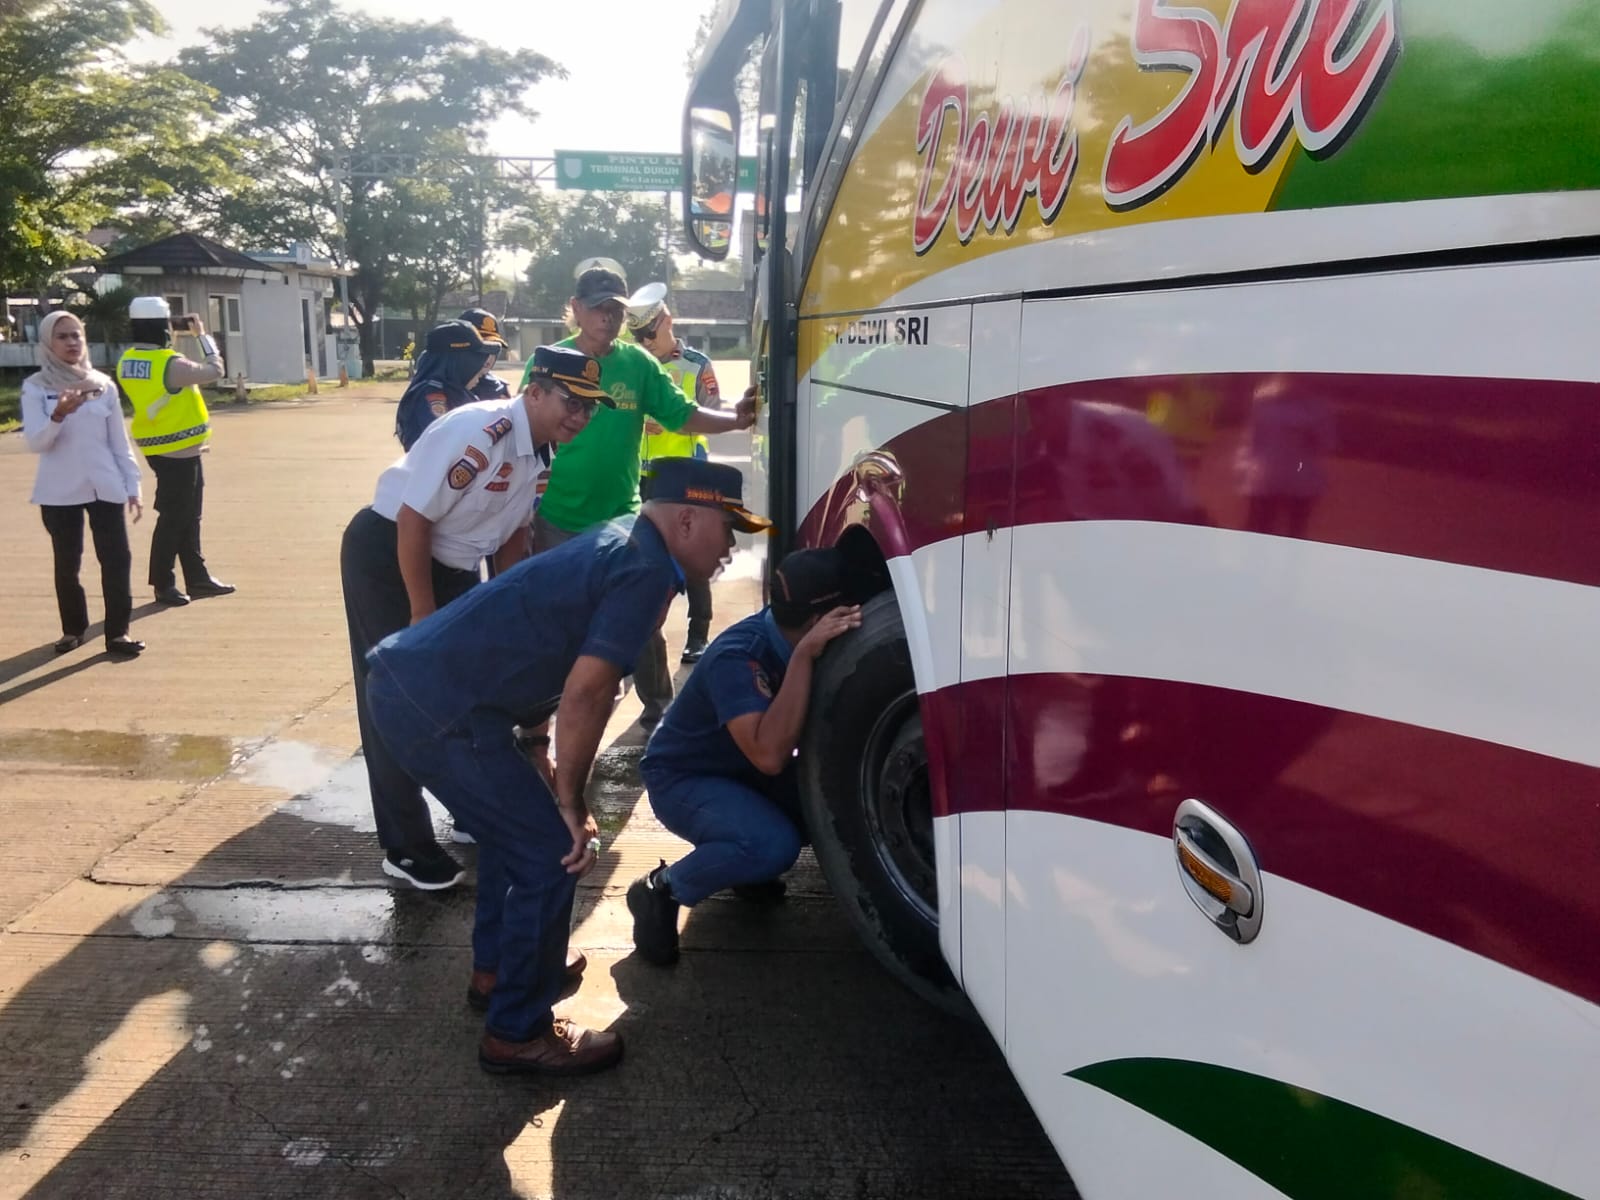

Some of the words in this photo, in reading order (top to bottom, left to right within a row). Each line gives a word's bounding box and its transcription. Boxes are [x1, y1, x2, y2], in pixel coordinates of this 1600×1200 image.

[608, 155, 659, 164] PINTU
[590, 164, 641, 174] TERMINAL
[643, 165, 680, 175] DUKUH
[621, 175, 675, 185] Selamat
[847, 319, 887, 345] DEWI
[894, 316, 929, 345] SRI
